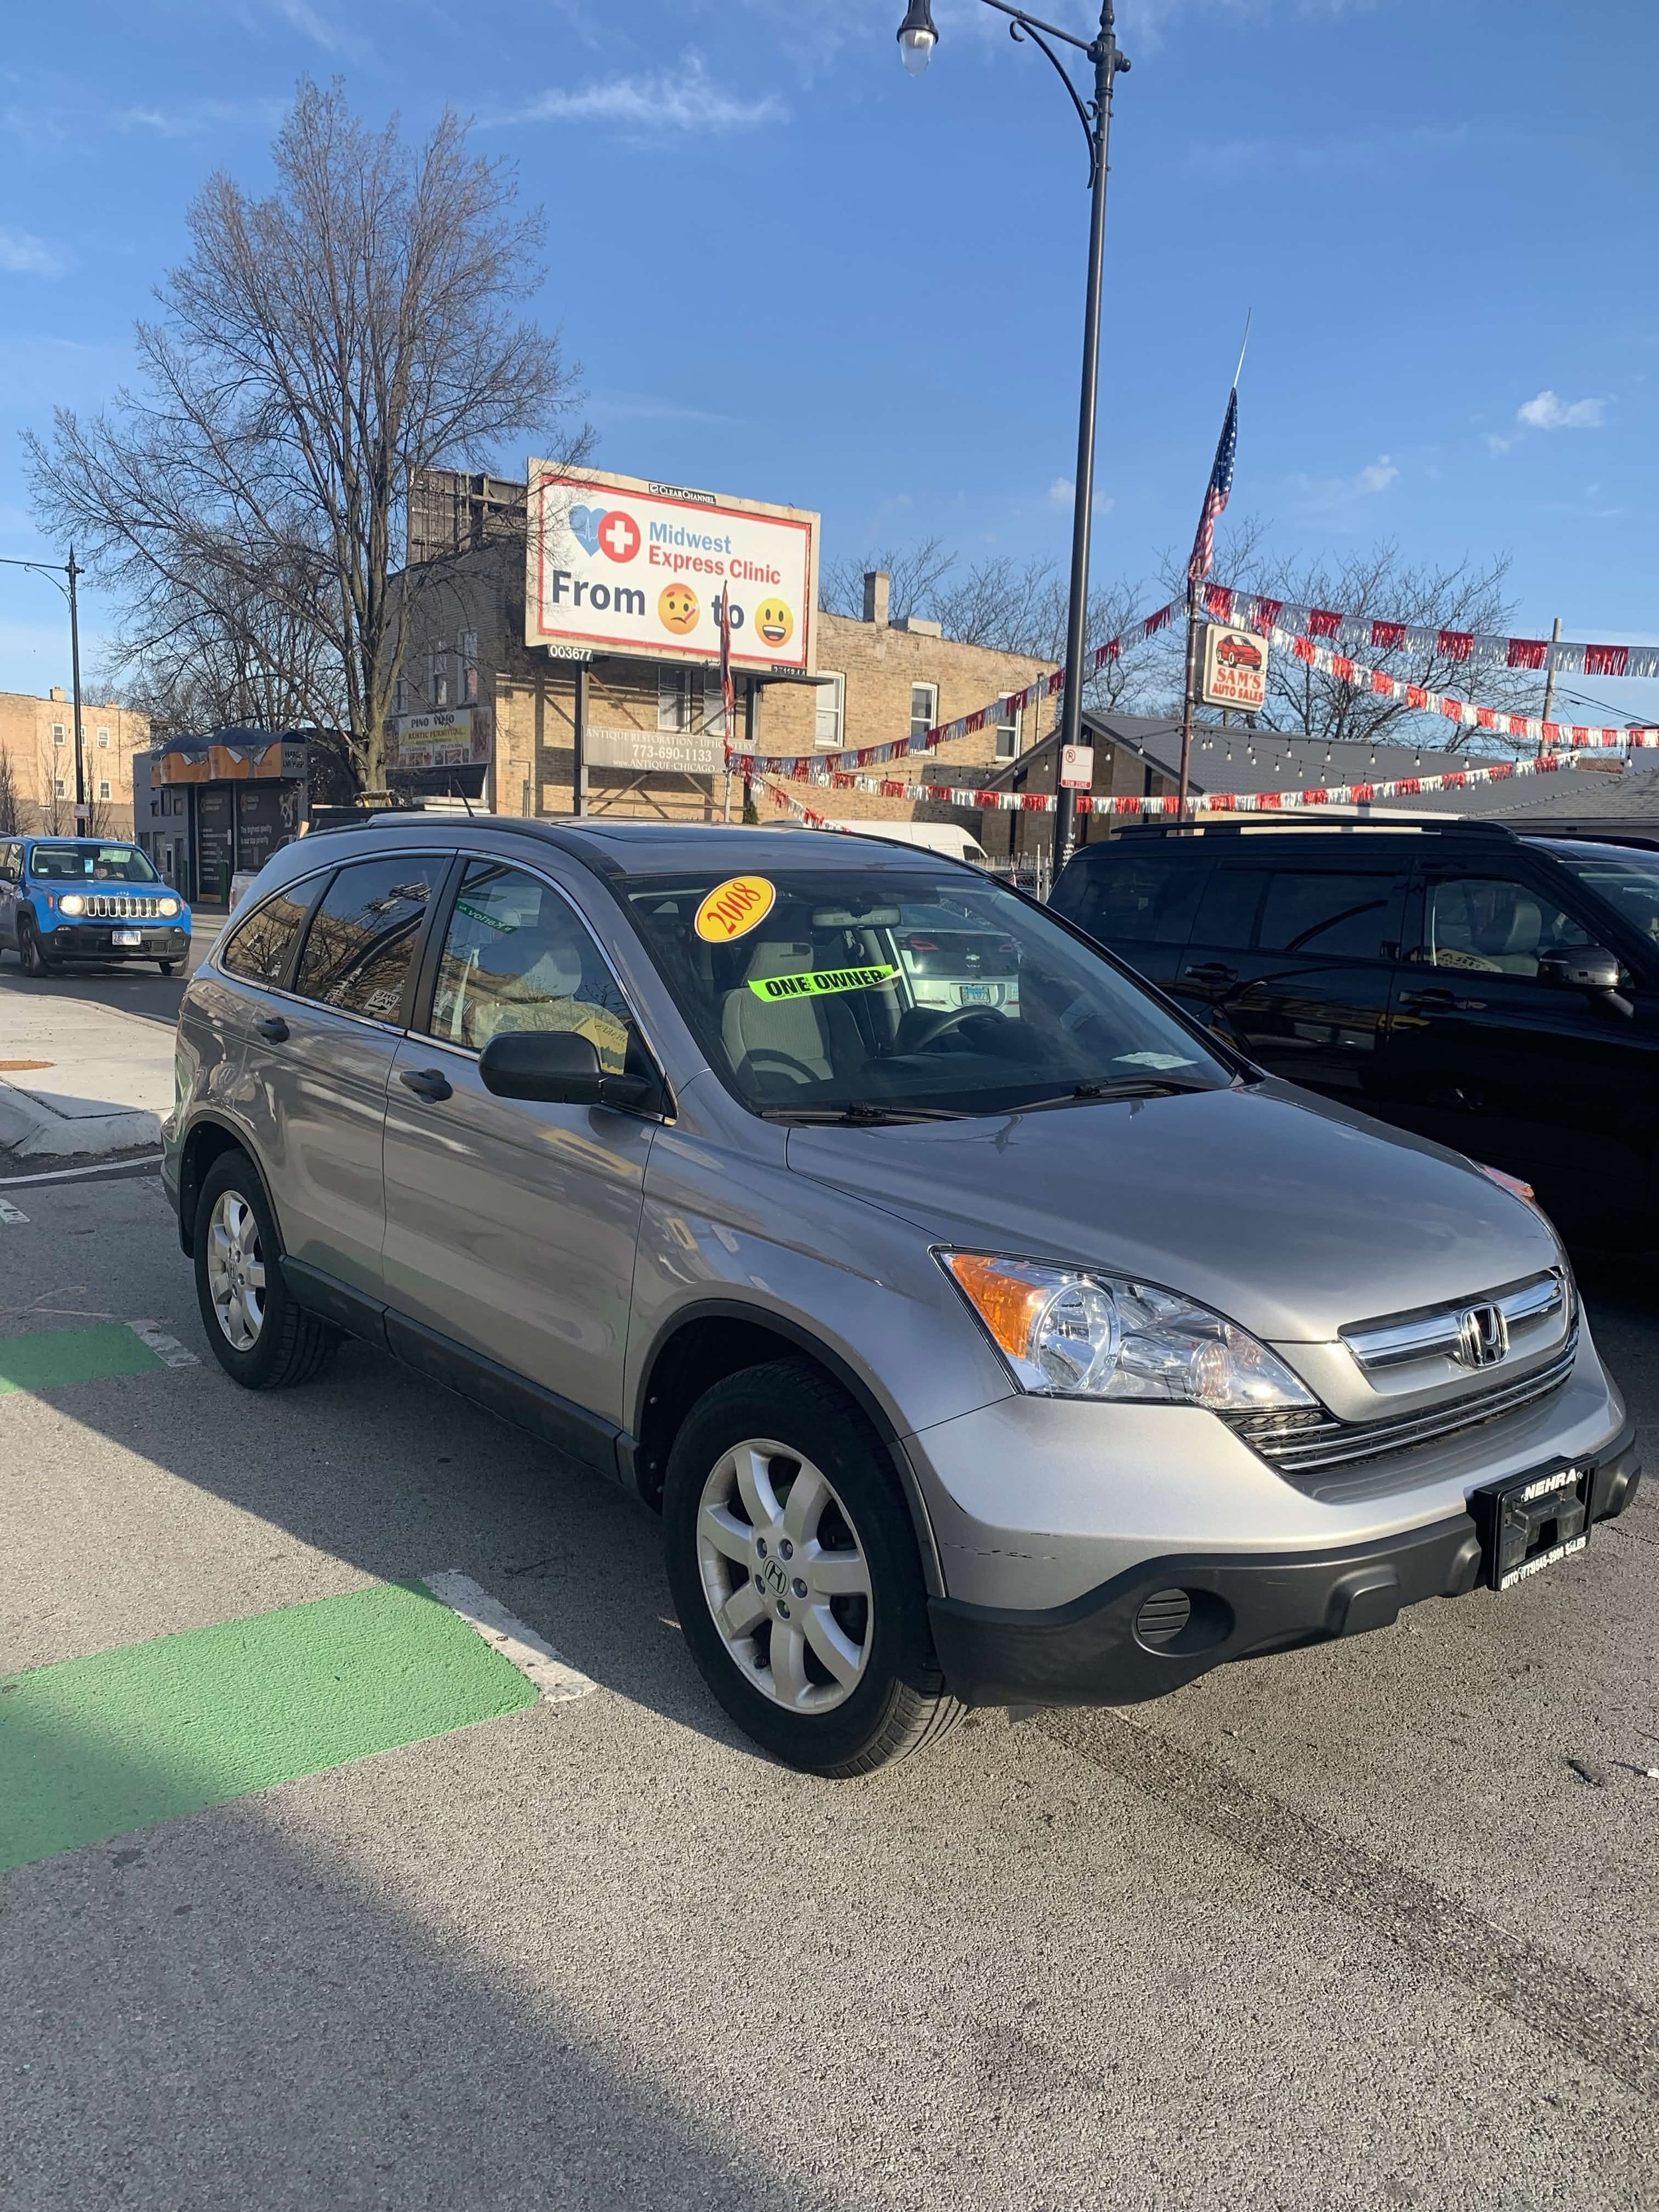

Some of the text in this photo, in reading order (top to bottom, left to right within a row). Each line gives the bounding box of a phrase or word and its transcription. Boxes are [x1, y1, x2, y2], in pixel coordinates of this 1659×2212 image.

[649, 522, 731, 555] Midwest
[649, 545, 781, 585] Express Clinic
[552, 569, 745, 629] From to
[549, 645, 593, 661] 003677
[1217, 668, 1262, 690] SAM'S
[1212, 683, 1263, 702] AUTO SALES
[411, 718, 429, 728] PINO
[586, 729, 629, 741] ANTIQUE
[631, 733, 693, 747] RESTORATION
[632, 744, 712, 763] 773-690-1133
[707, 881, 762, 934] 2008
[764, 969, 885, 997] ONE OWNER
[1525, 1468, 1577, 1501] NEHRA
[1501, 1570, 1519, 1591] AUTO
